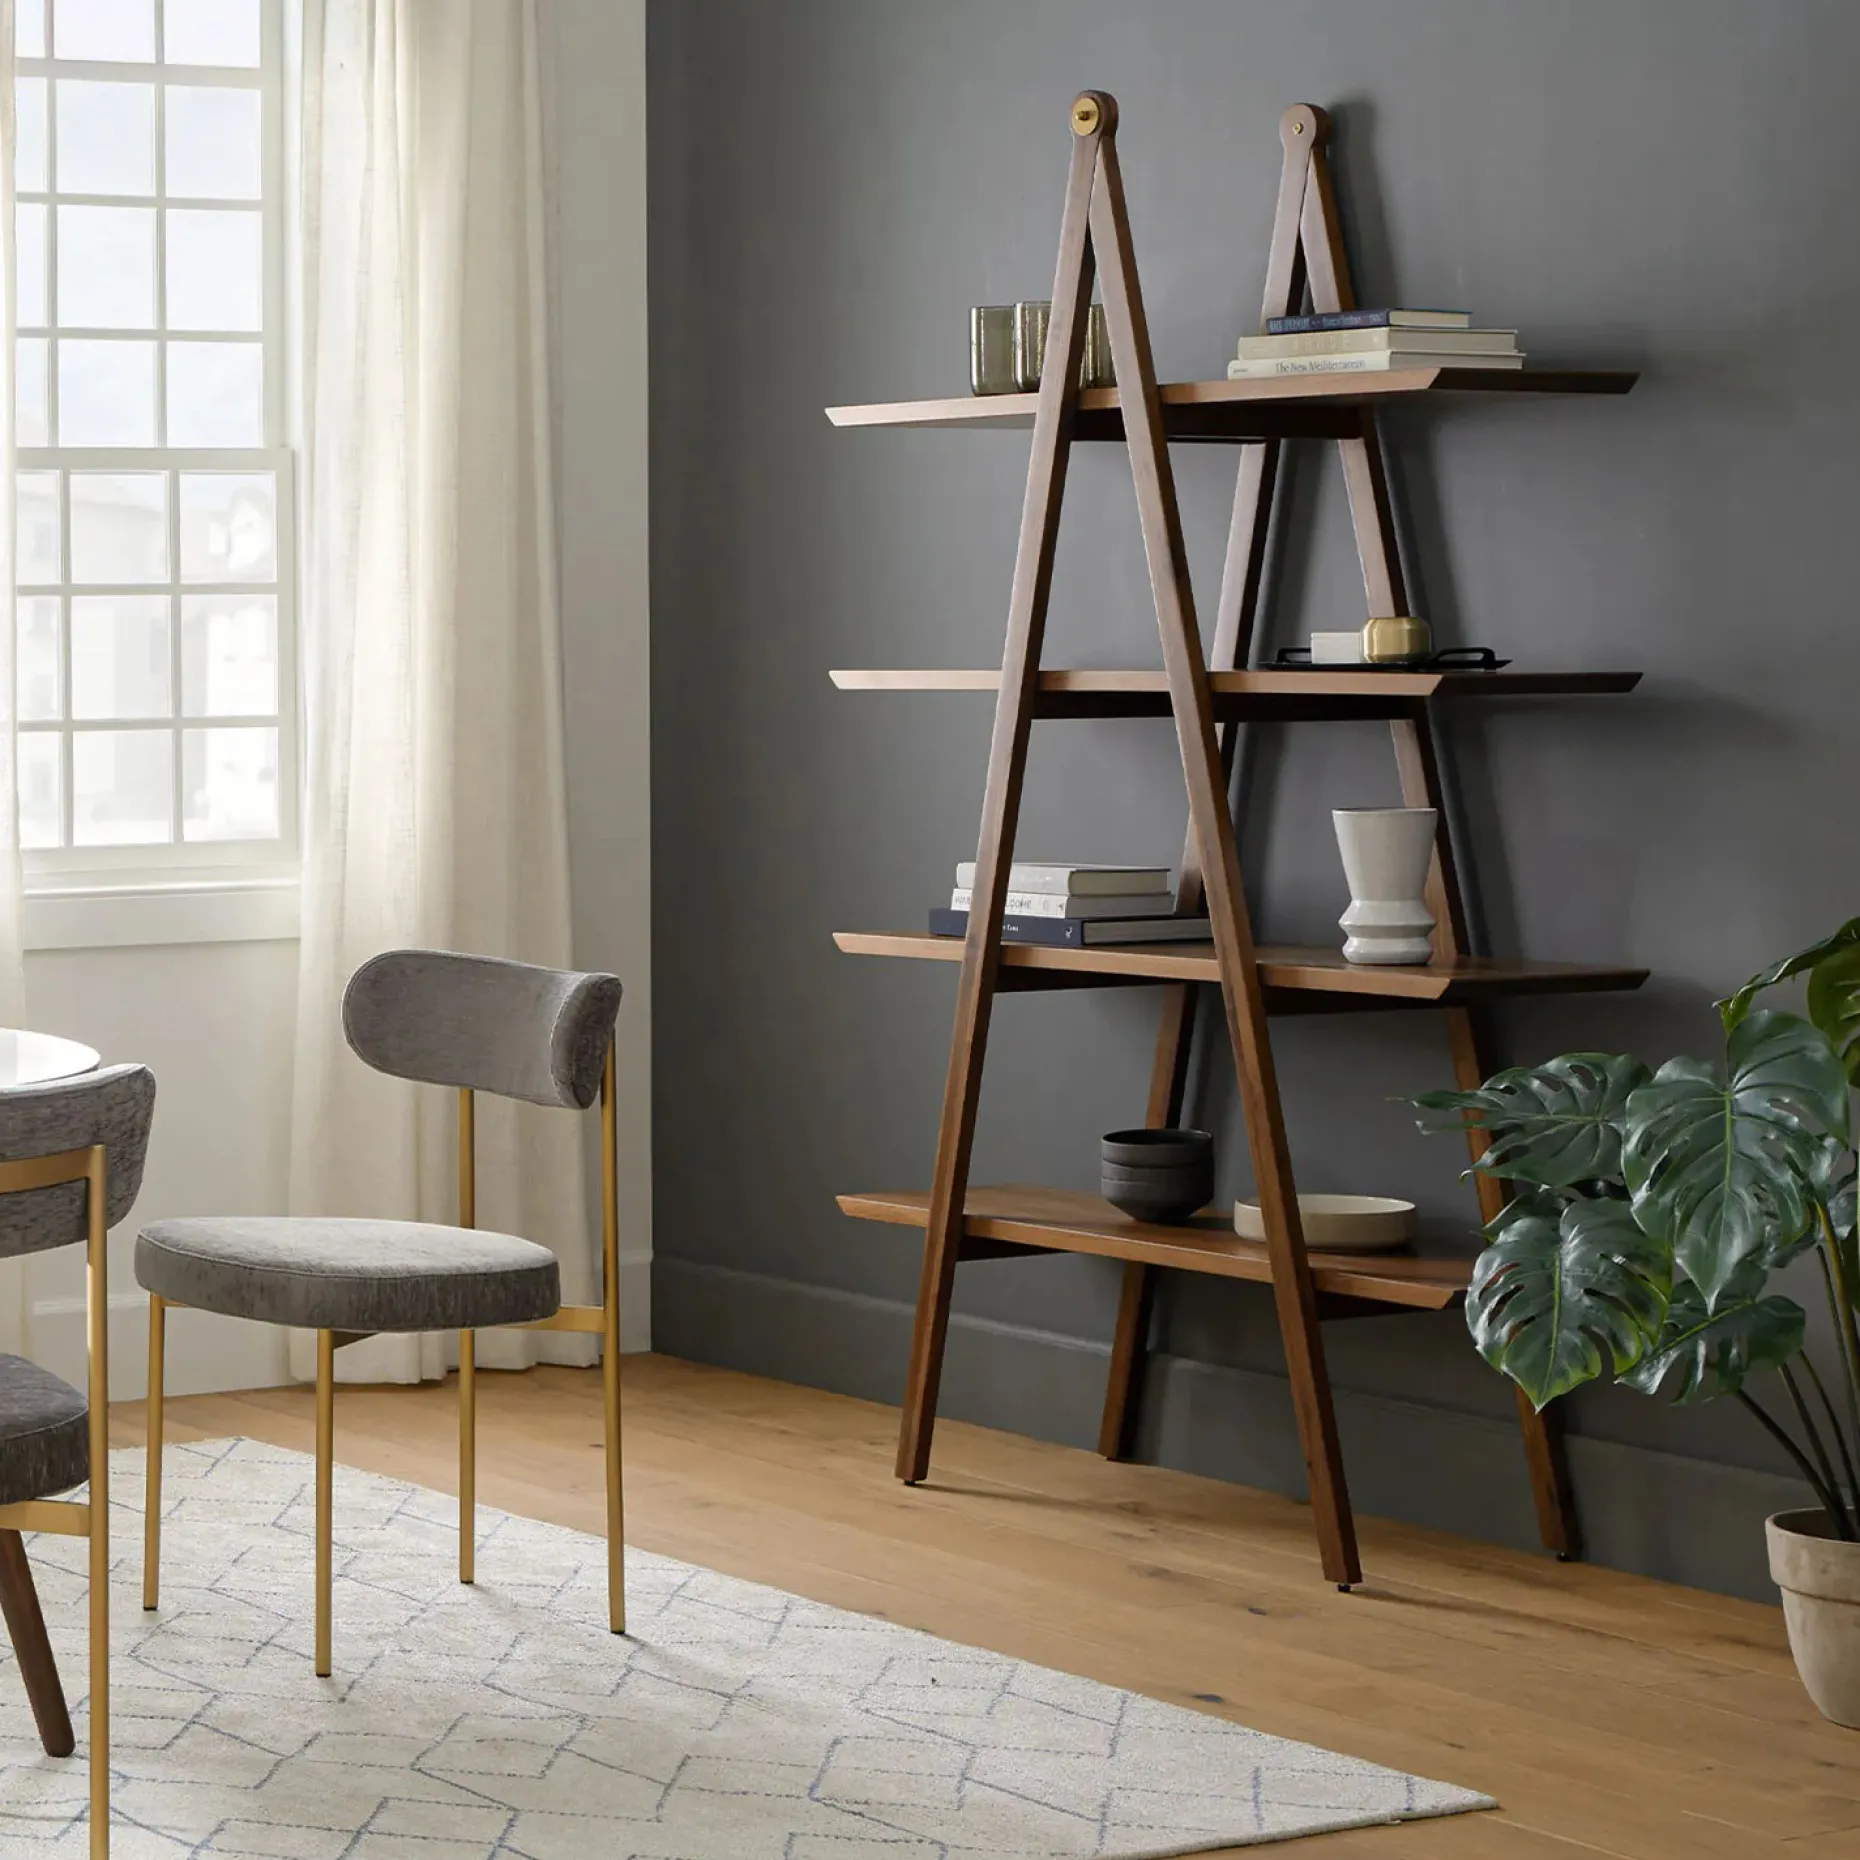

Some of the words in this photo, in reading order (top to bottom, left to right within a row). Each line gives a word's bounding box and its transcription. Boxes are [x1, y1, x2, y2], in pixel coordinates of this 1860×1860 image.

[1276, 361, 1290, 373] The
[1291, 362, 1308, 373] New
[1309, 359, 1366, 372] Mediterranean
